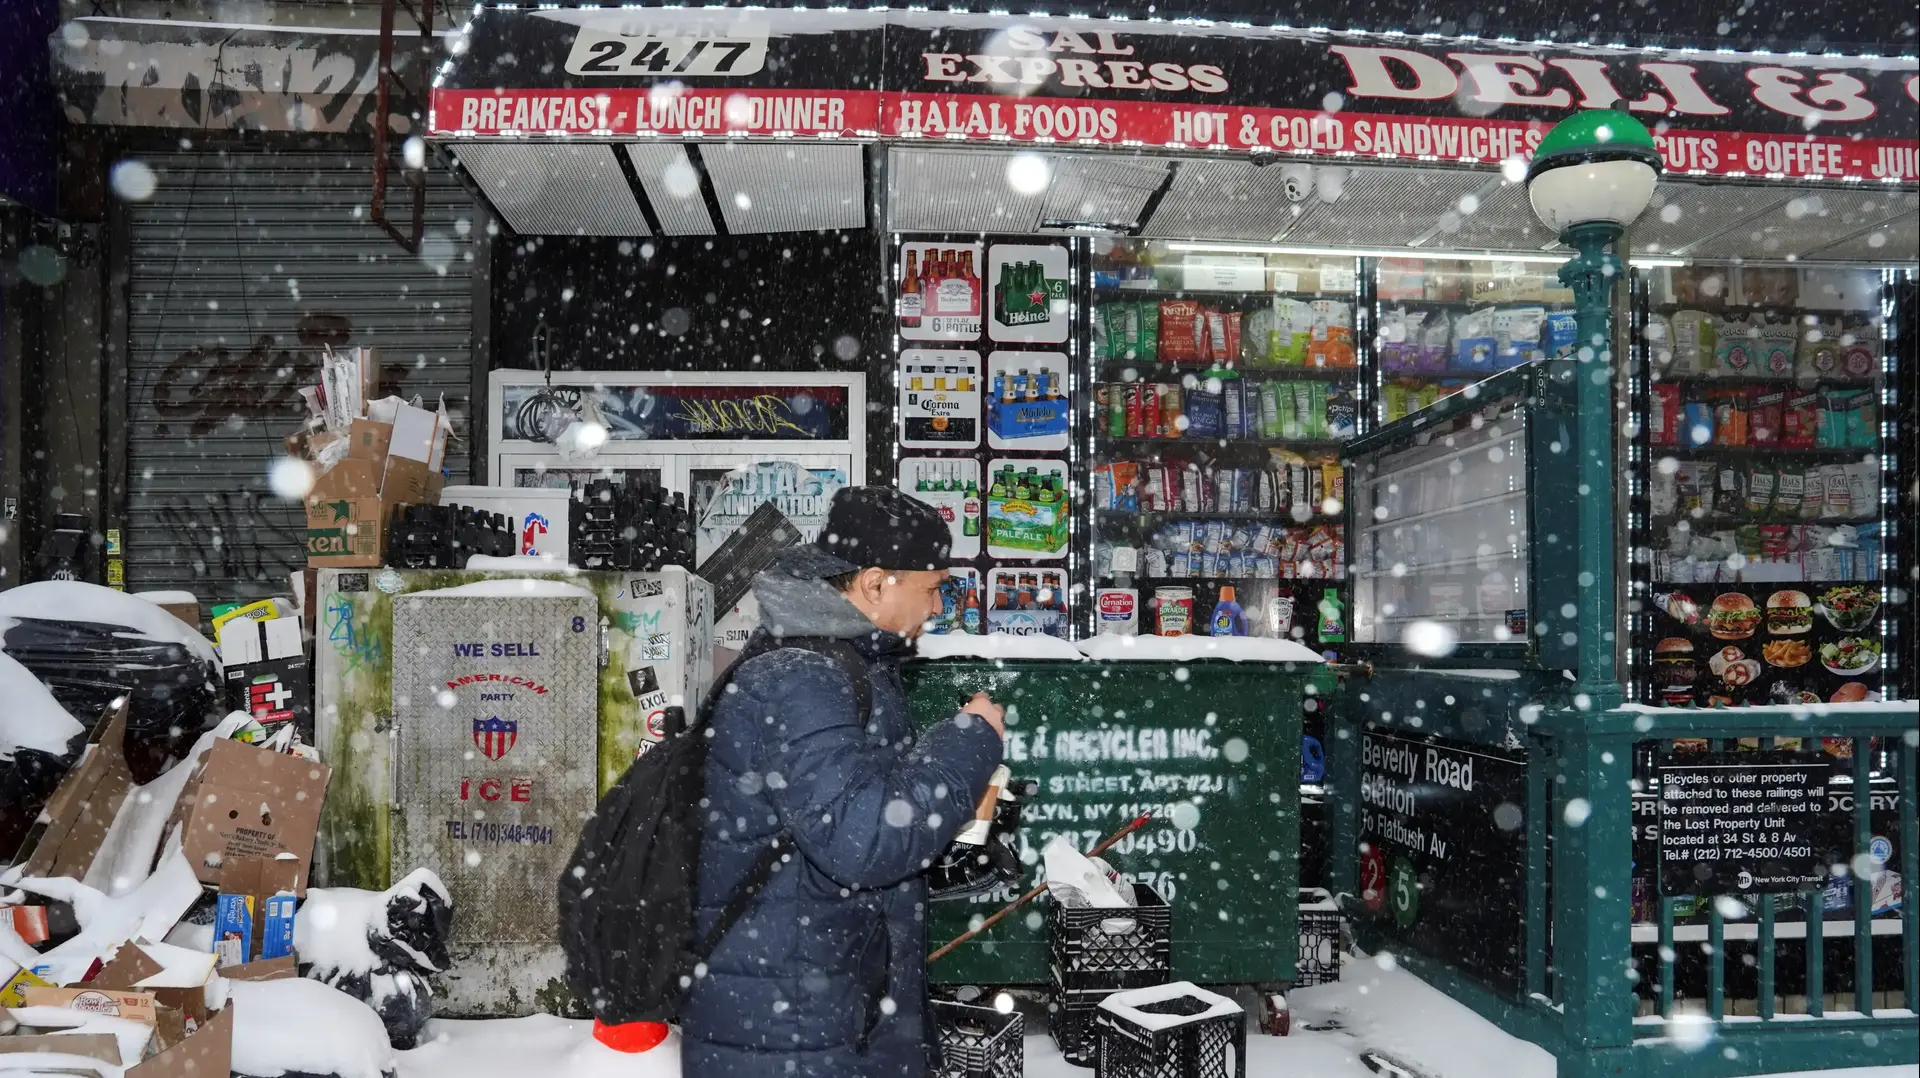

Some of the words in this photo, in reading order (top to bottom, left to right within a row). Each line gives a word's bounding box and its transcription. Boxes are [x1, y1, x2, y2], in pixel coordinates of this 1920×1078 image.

[1007, 26, 1135, 56] SAL
[580, 41, 752, 73] 24/7
[922, 52, 1229, 94] EXPRESS
[1328, 44, 1732, 116] DELI
[1746, 66, 1878, 122] &
[462, 97, 611, 131] BREAKFAST
[637, 96, 722, 131] LUNCH
[751, 97, 846, 132] DINNER
[900, 101, 1008, 135] HALAL
[1014, 105, 1118, 139] FOODS
[1173, 111, 1229, 144] HOT
[1240, 116, 1261, 146] &
[1271, 117, 1345, 151] COLD
[1354, 121, 1542, 162] SANDWICHES
[1654, 135, 1718, 171] CUTS
[1747, 139, 1844, 175] COFFEE
[1054, 281, 1062, 292] 6
[932, 317, 941, 333] 6
[946, 323, 982, 334] BOTTLES
[1759, 328, 1798, 339] POPCORN
[921, 398, 960, 411] Corona
[931, 408, 951, 416] Extra
[996, 529, 1020, 539] PALE
[1023, 531, 1042, 541] ALE
[1100, 596, 1133, 608] Carnation
[571, 616, 586, 633] 8
[1218, 618, 1228, 627] all
[453, 643, 484, 657] WE
[490, 642, 540, 657] SELL
[445, 674, 549, 695] AMERICAN
[481, 693, 515, 701] PARTY
[1055, 728, 1169, 762] RECYCLER
[1172, 728, 1219, 760] INC.
[1361, 735, 1418, 784] Beverly
[1425, 748, 1474, 792] Road
[1050, 774, 1135, 795] STREET,
[1663, 772, 1709, 786] Bicycles
[1713, 775, 1724, 784] or
[1729, 772, 1757, 783] other
[1761, 772, 1807, 784] property
[460, 776, 534, 803] ICE
[1361, 771, 1416, 817] Station
[1663, 788, 1713, 799] attached
[1716, 788, 1727, 799] to
[1732, 787, 1762, 798] these
[1766, 786, 1804, 799] railings
[1807, 786, 1824, 797] will
[1084, 803, 1113, 819] NY
[1663, 804, 1677, 815] be
[1681, 803, 1729, 815] removed
[1733, 802, 1753, 813] and
[1757, 802, 1806, 813] delivered
[1810, 802, 1821, 812] to
[446, 821, 468, 840] TEL
[1663, 819, 1681, 829] the
[1685, 818, 1709, 829] Lost
[1713, 818, 1760, 830] Property
[1764, 817, 1785, 828] Unit
[235, 826, 267, 839] PROPERTY
[1362, 808, 1374, 832] To
[1377, 814, 1425, 852] Flatbush
[1429, 832, 1447, 859] Av
[1663, 833, 1704, 845] located
[1708, 834, 1719, 844] at
[1723, 833, 1738, 844] 34
[1742, 832, 1755, 843] St
[1758, 832, 1767, 843] &
[1771, 832, 1779, 843] 8
[1783, 832, 1796, 842] Av
[1663, 848, 1690, 860] Tel.#
[1693, 847, 1720, 860] (212)
[1724, 846, 1811, 859] 712-4500/4501
[1368, 858, 1379, 897] 2
[1397, 871, 1410, 912] 5
[1770, 875, 1785, 883] York
[1786, 875, 1799, 884] City
